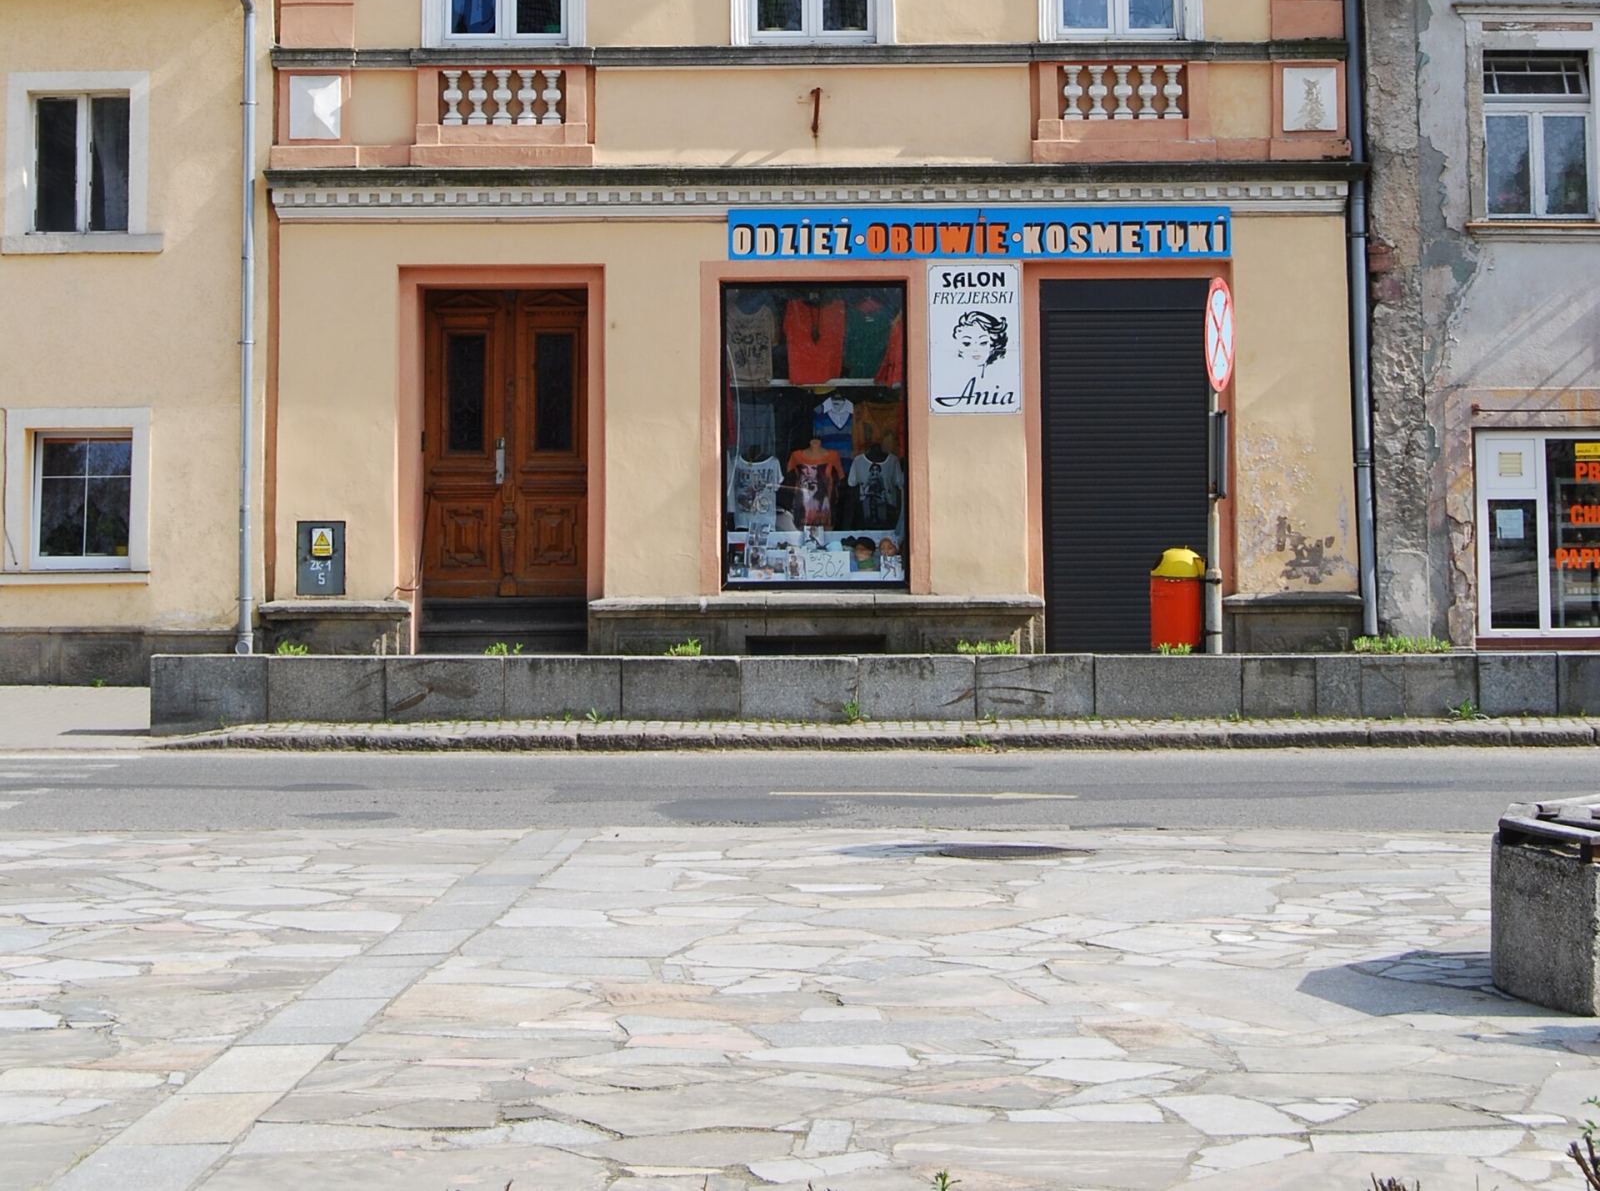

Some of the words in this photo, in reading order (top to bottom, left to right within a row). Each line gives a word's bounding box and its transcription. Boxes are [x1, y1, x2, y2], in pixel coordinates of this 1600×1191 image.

[866, 215, 1010, 255] OBUWIE
[1022, 215, 1227, 254] KOSMETYKI
[941, 271, 1006, 289] SALON
[932, 291, 1014, 305] FRYZJERSKI
[934, 376, 1015, 407] Ania
[1570, 504, 1600, 525] CH
[807, 560, 845, 578] -20%
